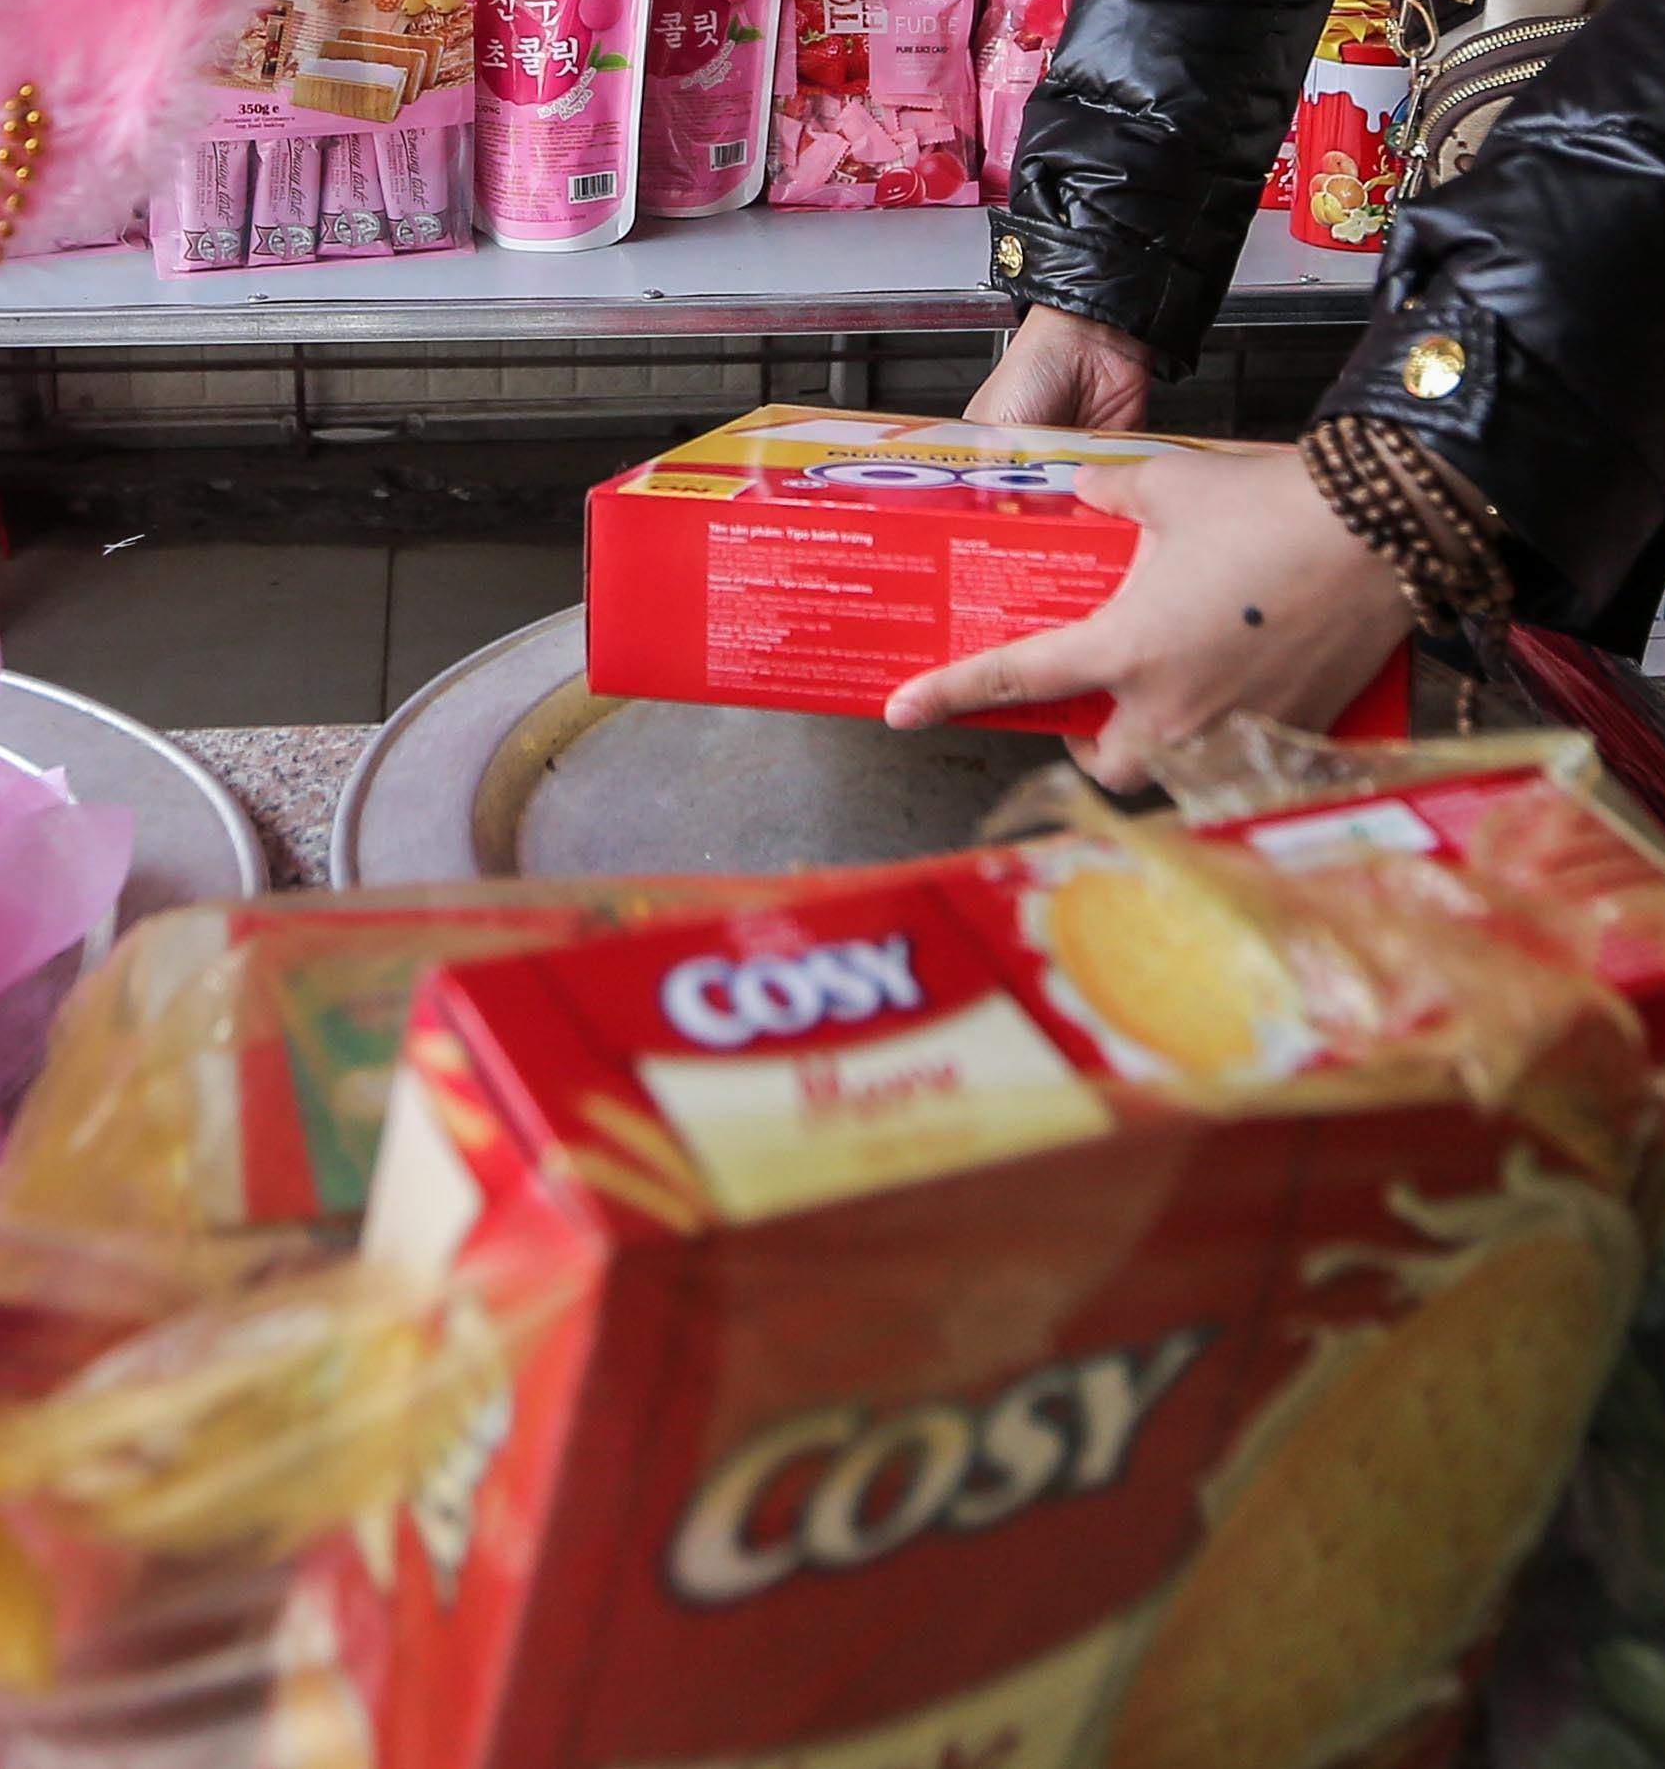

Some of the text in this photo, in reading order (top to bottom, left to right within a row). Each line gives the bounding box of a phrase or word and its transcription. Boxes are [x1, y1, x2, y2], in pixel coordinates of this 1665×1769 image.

[654, 9, 720, 49] 콜릿
[239, 103, 270, 116] 350g
[802, 458, 1080, 494] po
[660, 933, 925, 1052] COSY
[661, 1326, 1223, 1608] COSY
